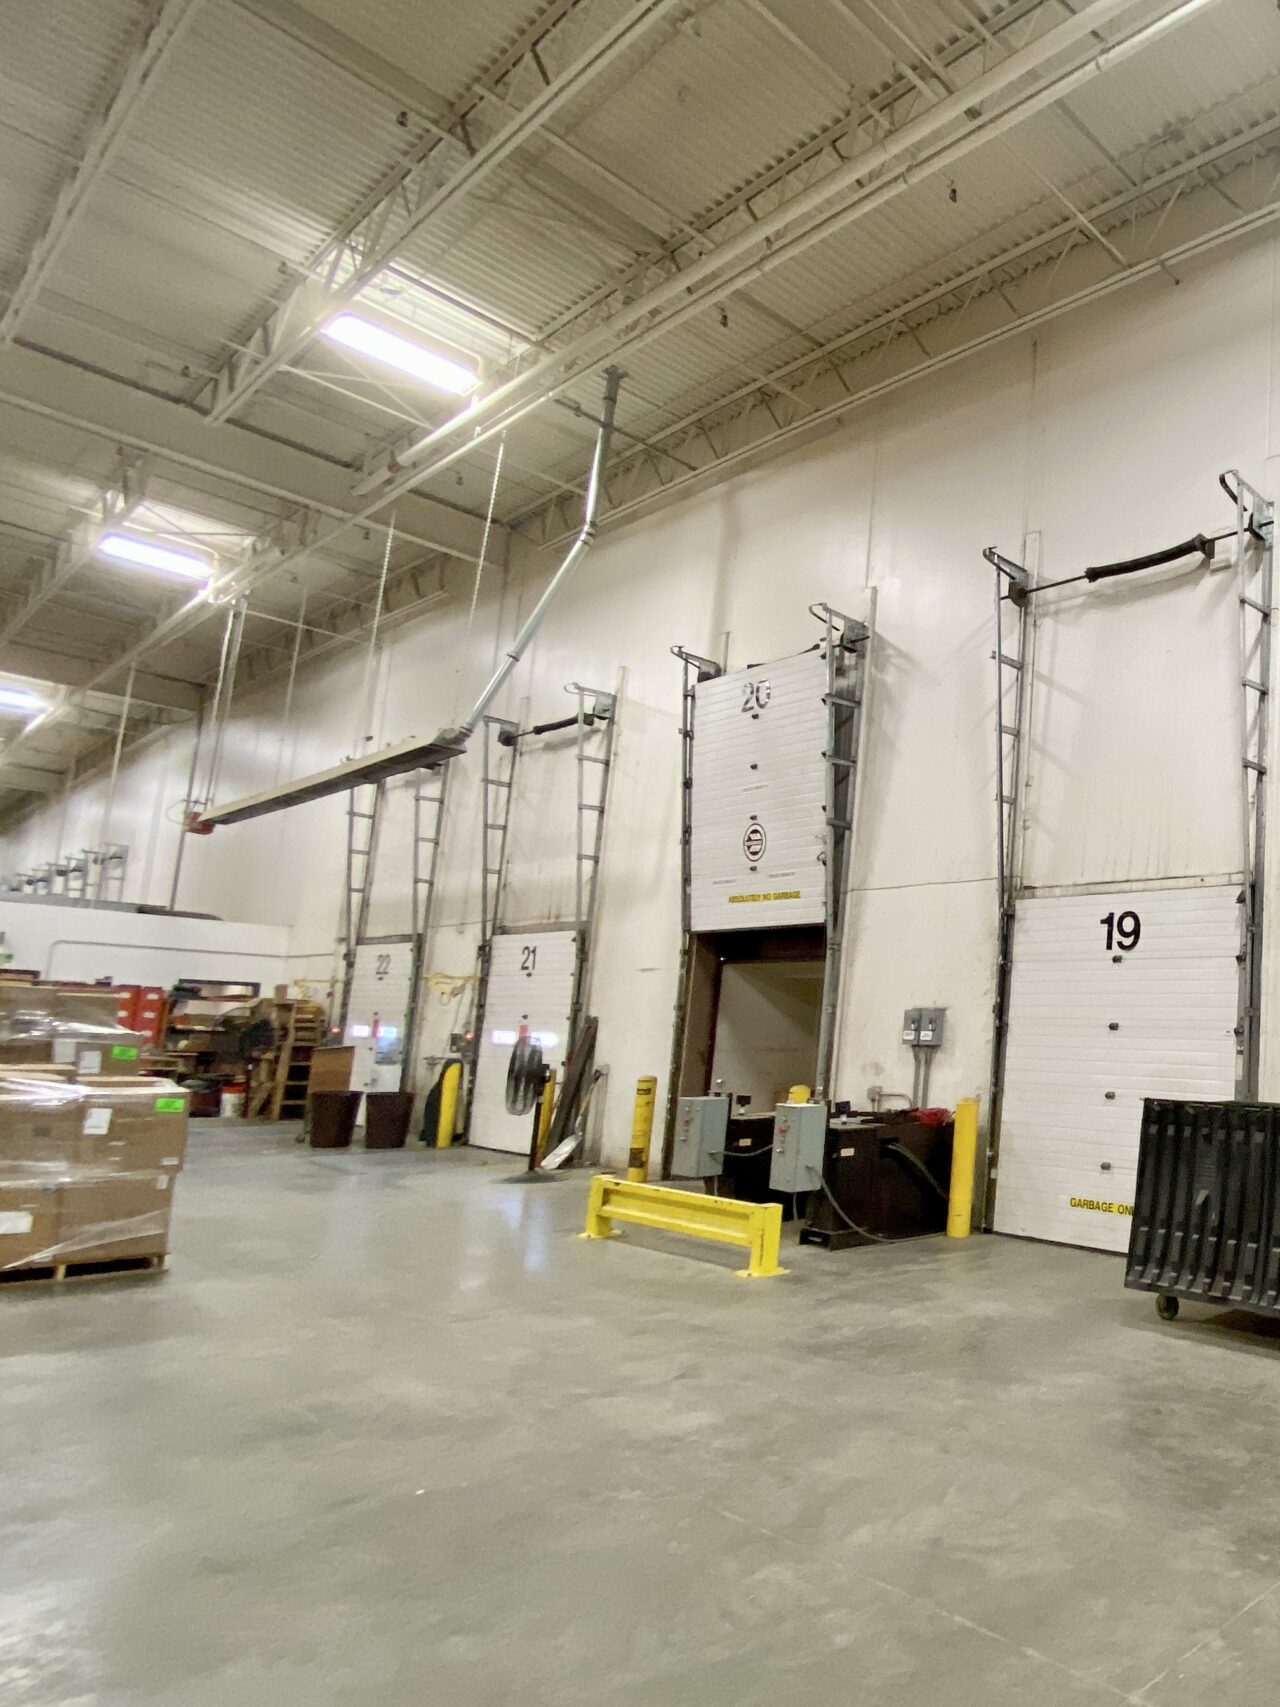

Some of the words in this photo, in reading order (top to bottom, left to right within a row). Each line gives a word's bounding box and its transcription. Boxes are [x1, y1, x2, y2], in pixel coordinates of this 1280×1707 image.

[741, 679, 771, 713] 20
[1100, 911, 1141, 951] 19
[375, 954, 391, 975] 22
[521, 946, 537, 970] 21
[1070, 1197, 1114, 1212] GARBAGE
